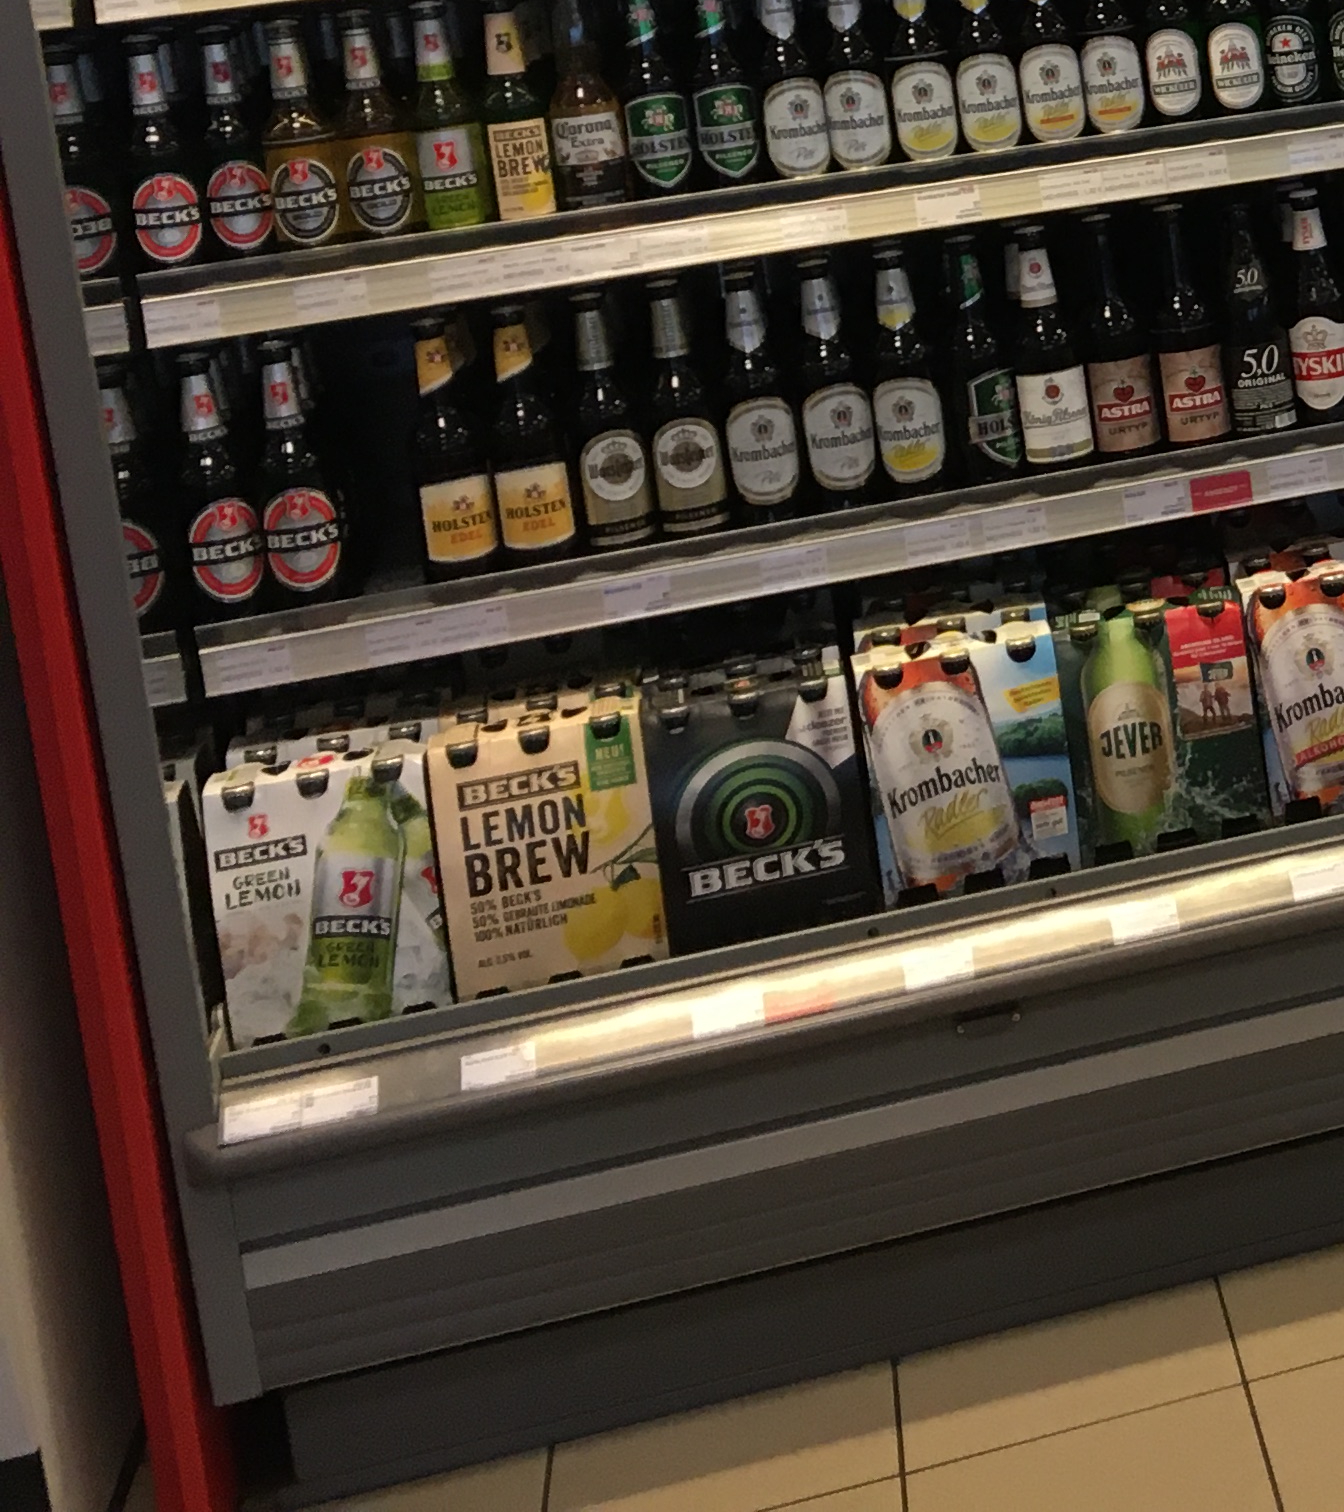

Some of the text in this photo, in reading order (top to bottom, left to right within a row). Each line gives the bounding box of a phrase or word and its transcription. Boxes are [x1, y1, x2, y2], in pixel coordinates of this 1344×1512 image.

[552, 117, 613, 141] Corona
[494, 137, 545, 157] LEMON
[497, 154, 549, 178] BREW
[348, 176, 410, 199] BECK'S
[423, 172, 477, 190] BECK'S
[209, 194, 272, 215] BECK'S
[274, 188, 337, 210] BECK'S
[135, 206, 200, 228] BECK'S
[1243, 345, 1279, 379] 5,0
[1237, 372, 1285, 389] ORIGINAL
[1101, 401, 1150, 420] ASTRA
[1171, 391, 1221, 409] ASTRA
[1109, 421, 1149, 436] URTYP
[1180, 412, 1221, 427] URTYP
[506, 499, 566, 521] HOLSTEN
[267, 522, 339, 549] BECK'S
[596, 744, 625, 759] NEU!
[1100, 728, 1163, 759] JEVER
[462, 763, 578, 807] BECK'S
[887, 764, 1000, 819] Krombacher
[460, 793, 586, 852] LEMON
[219, 836, 306, 869] BECK'S
[466, 831, 591, 898] BREW
[688, 838, 846, 898] BECK'S
[232, 867, 290, 891] GREEN
[225, 881, 301, 910] LEMON
[470, 897, 497, 914] 50%
[314, 917, 390, 936] BECK'S
[471, 912, 499, 928] 50%
[504, 913, 568, 935] NATÜRLICH
